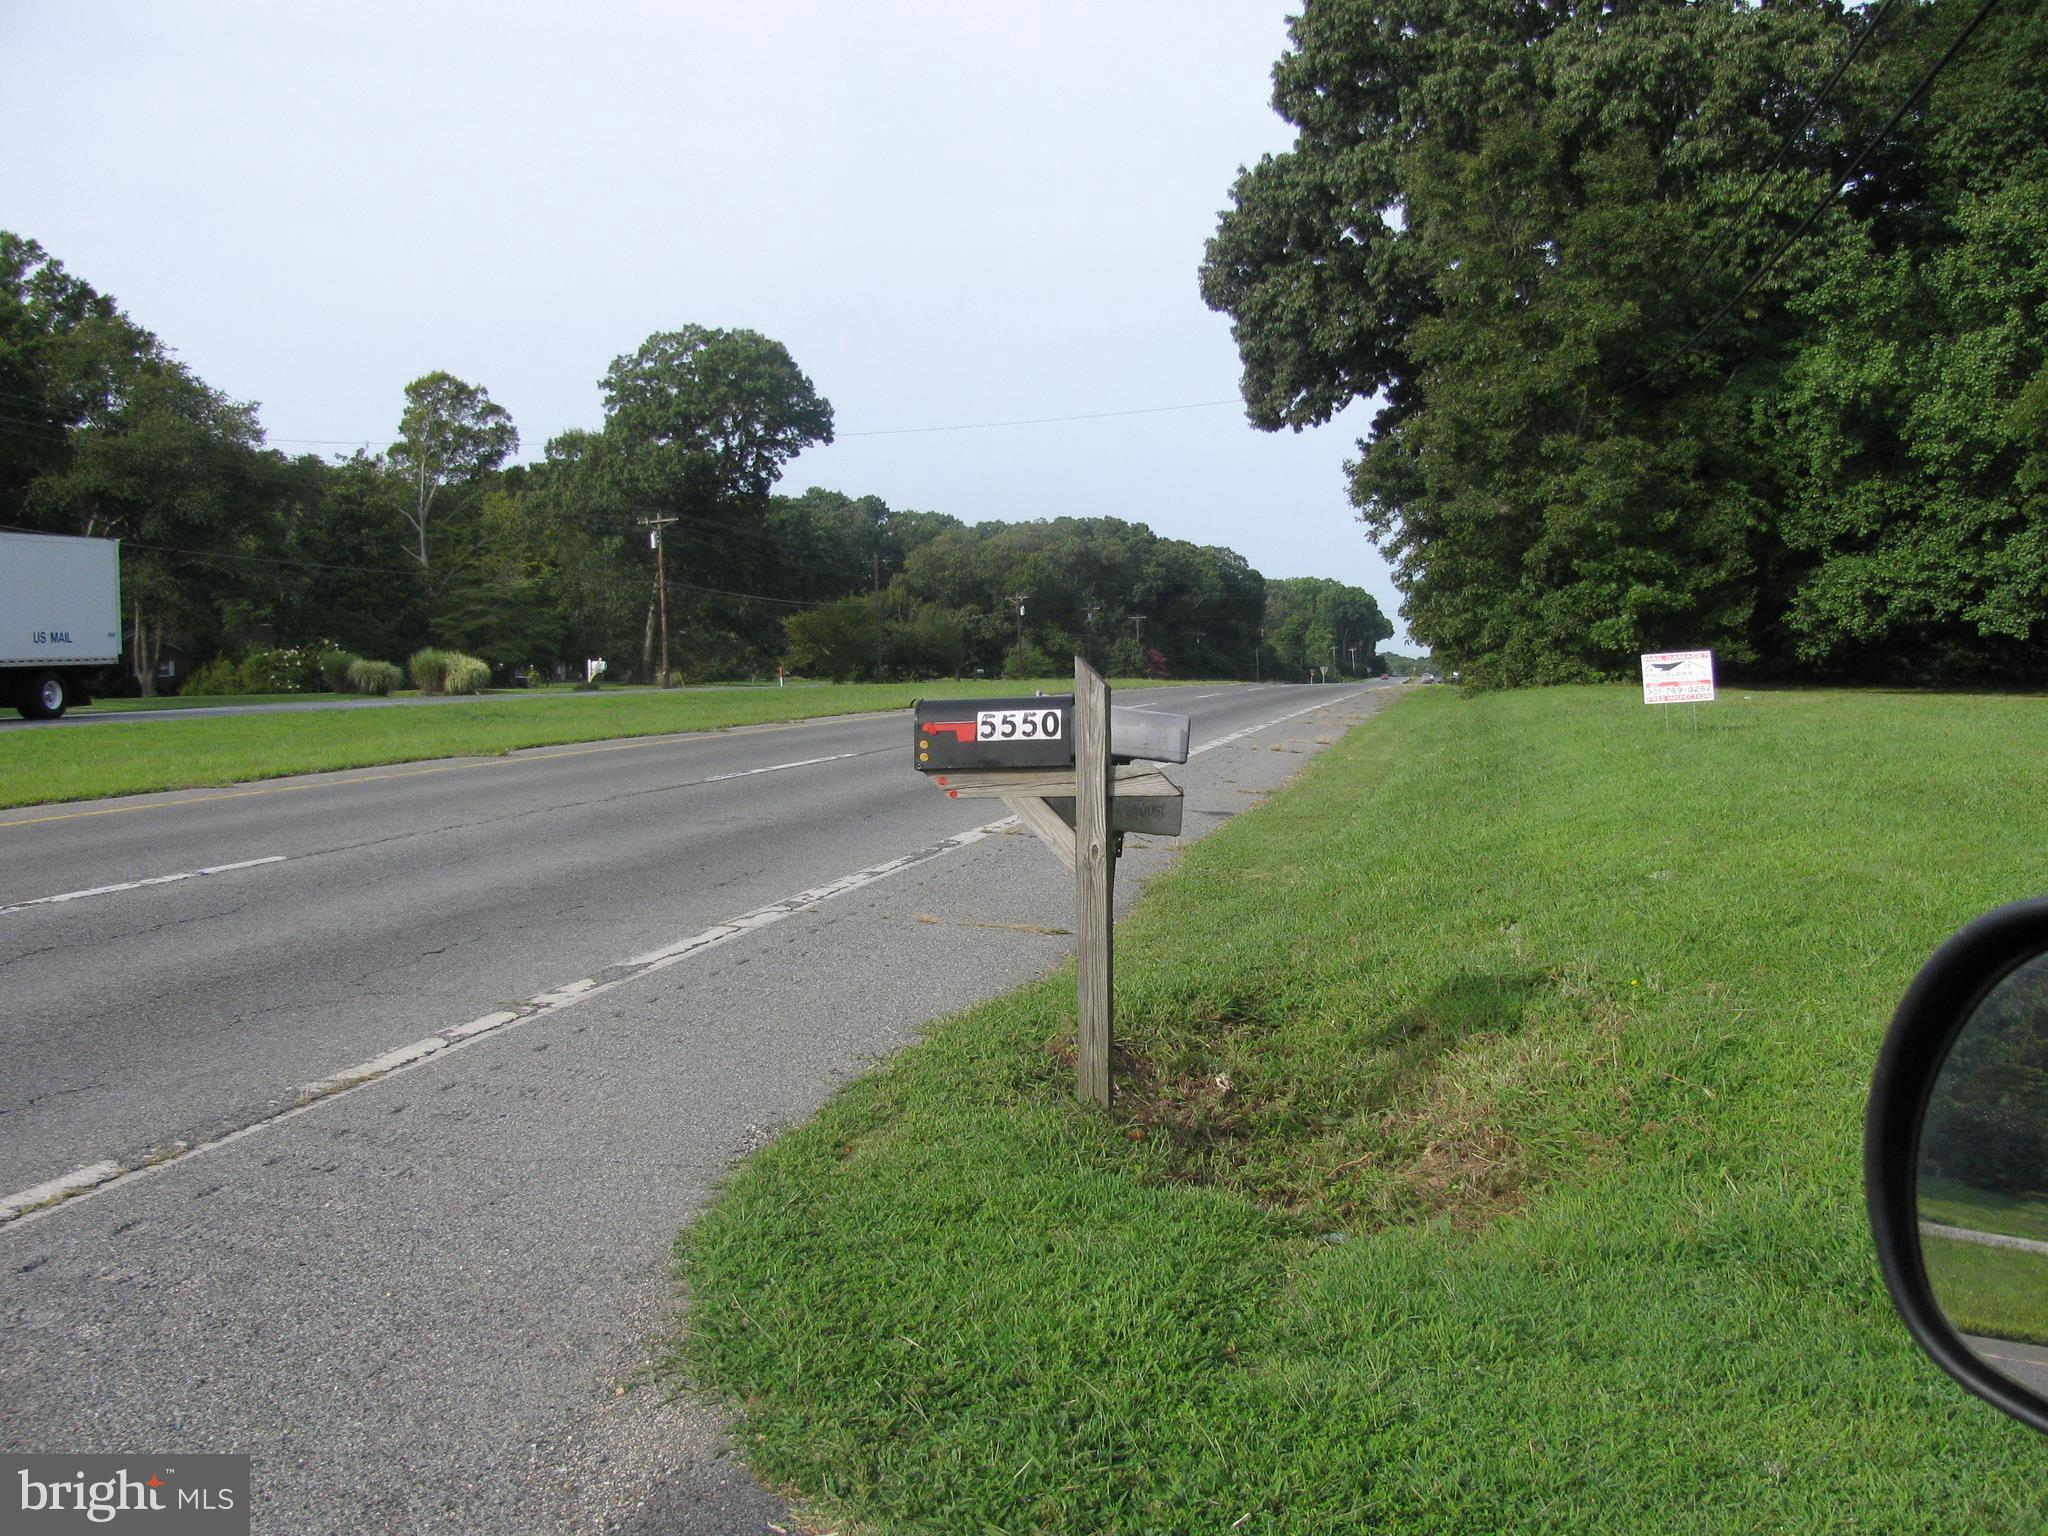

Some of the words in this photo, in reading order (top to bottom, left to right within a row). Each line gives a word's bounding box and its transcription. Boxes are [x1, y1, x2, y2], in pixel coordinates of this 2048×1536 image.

[33, 631, 46, 643] US
[50, 631, 73, 643] MAIL
[980, 710, 1060, 739] 5550
